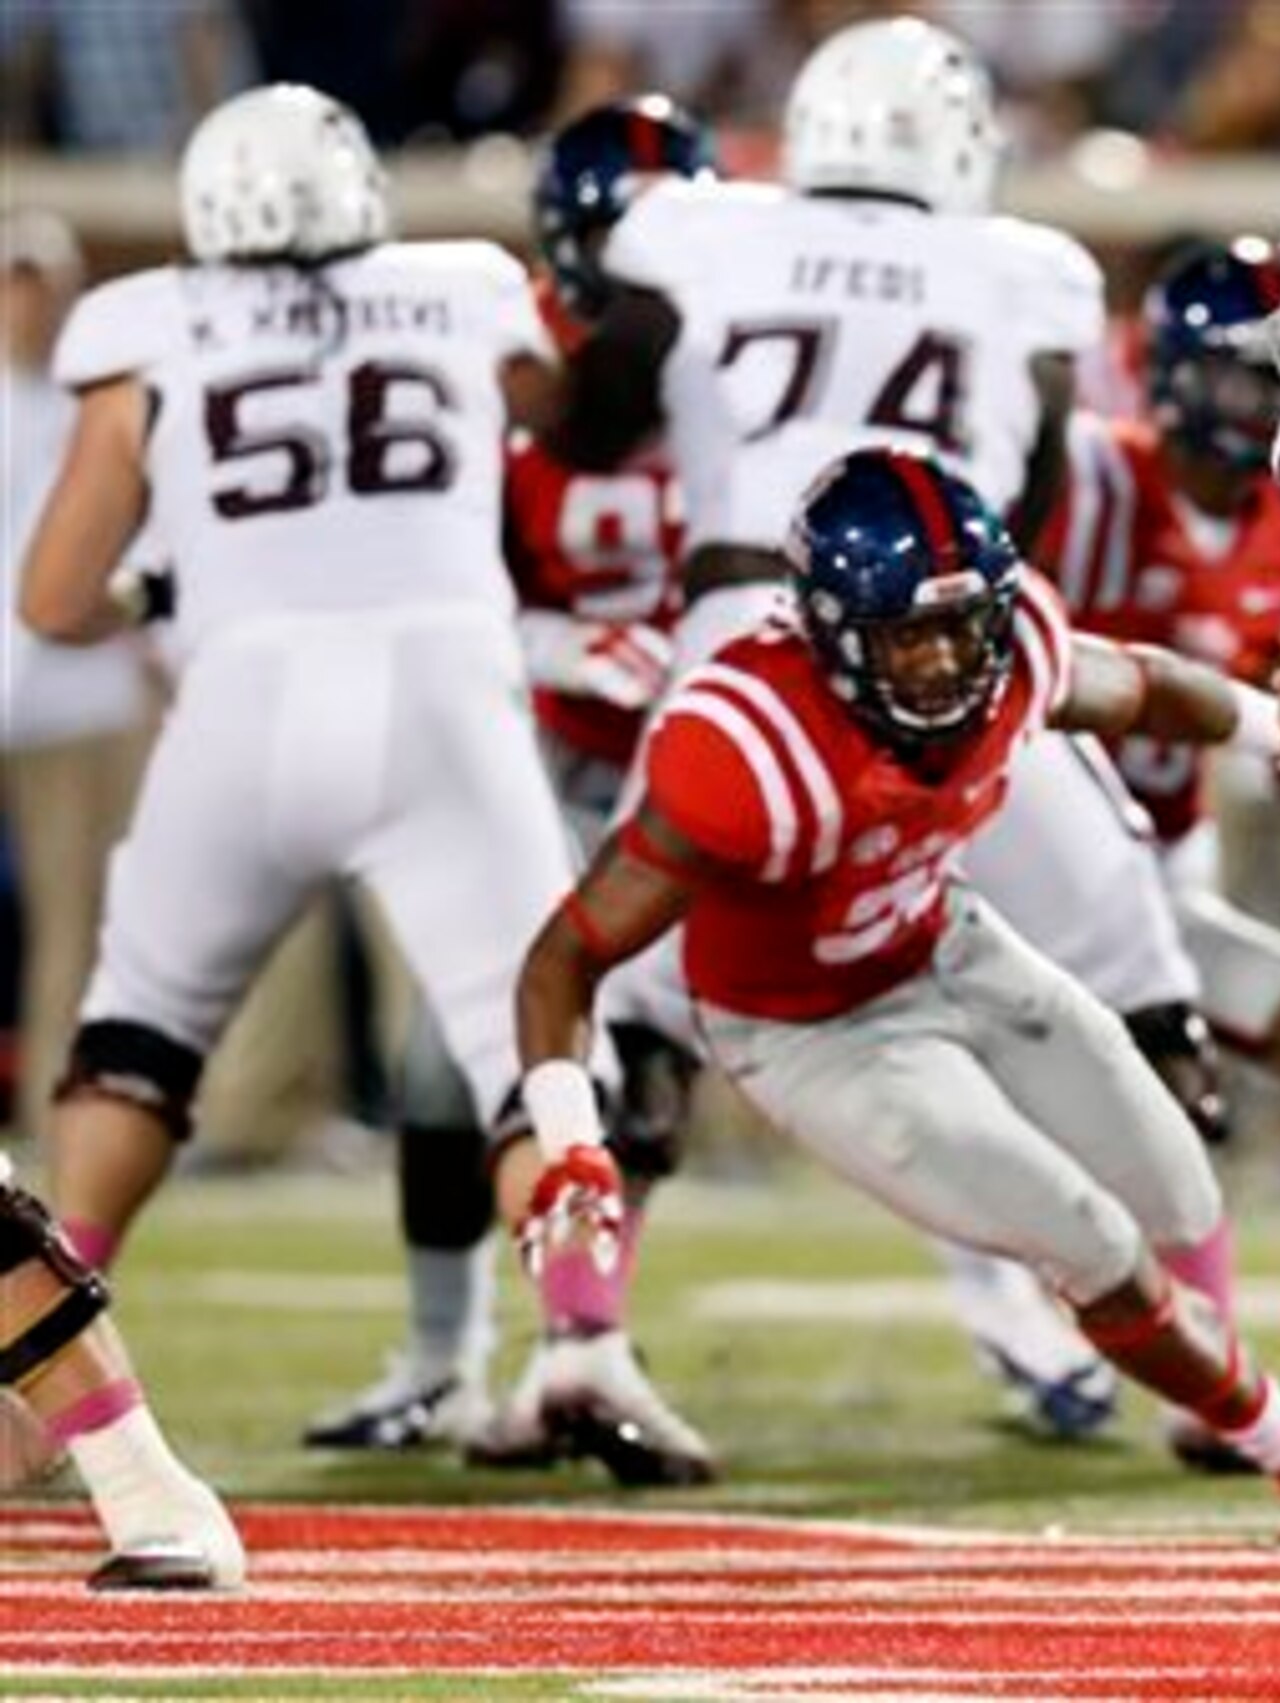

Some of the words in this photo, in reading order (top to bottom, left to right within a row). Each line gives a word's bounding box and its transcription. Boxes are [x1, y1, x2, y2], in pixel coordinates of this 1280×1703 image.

[202, 357, 458, 521] 56
[716, 315, 976, 456] 74
[557, 471, 688, 622] 9
